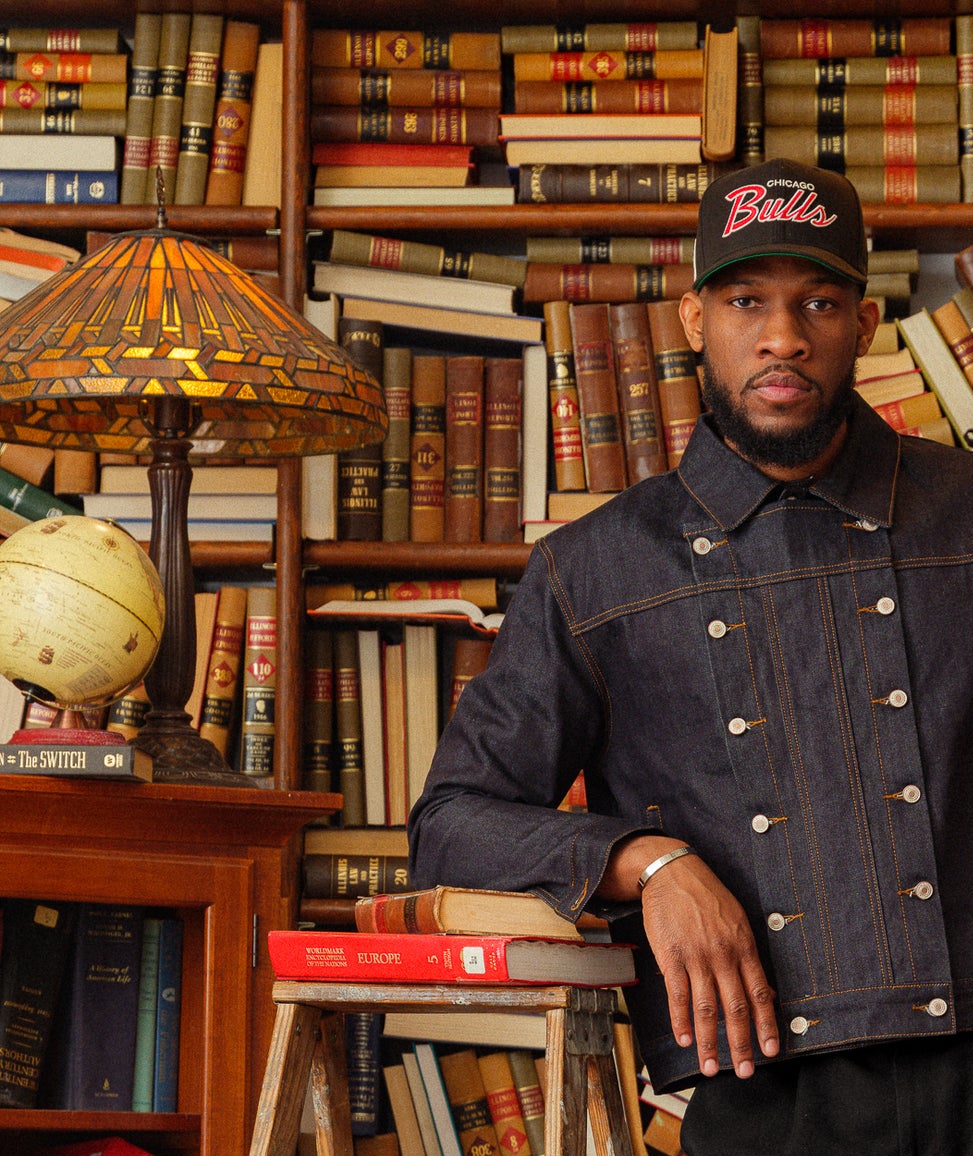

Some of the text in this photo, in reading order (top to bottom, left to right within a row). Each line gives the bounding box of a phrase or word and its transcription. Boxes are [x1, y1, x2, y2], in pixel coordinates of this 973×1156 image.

[686, 172, 698, 190] LAW
[766, 179, 816, 191] CHICAGO
[722, 184, 838, 238] Bulls
[629, 382, 650, 398] 257
[416, 451, 436, 465] 311
[350, 486, 369, 497] LAW
[342, 497, 378, 509] ILLINOIS
[253, 662, 272, 676] 110
[18, 751, 88, 769] The SWITCH
[337, 858, 348, 894] ILLINOIS
[349, 867, 359, 885] LAW
[395, 868, 408, 886] 20
[305, 947, 345, 955] WORLDMARK
[357, 952, 402, 965] EUROPE
[427, 954, 439, 965] 5
[510, 1135, 519, 1148] 8
[470, 1143, 491, 1156] 308
